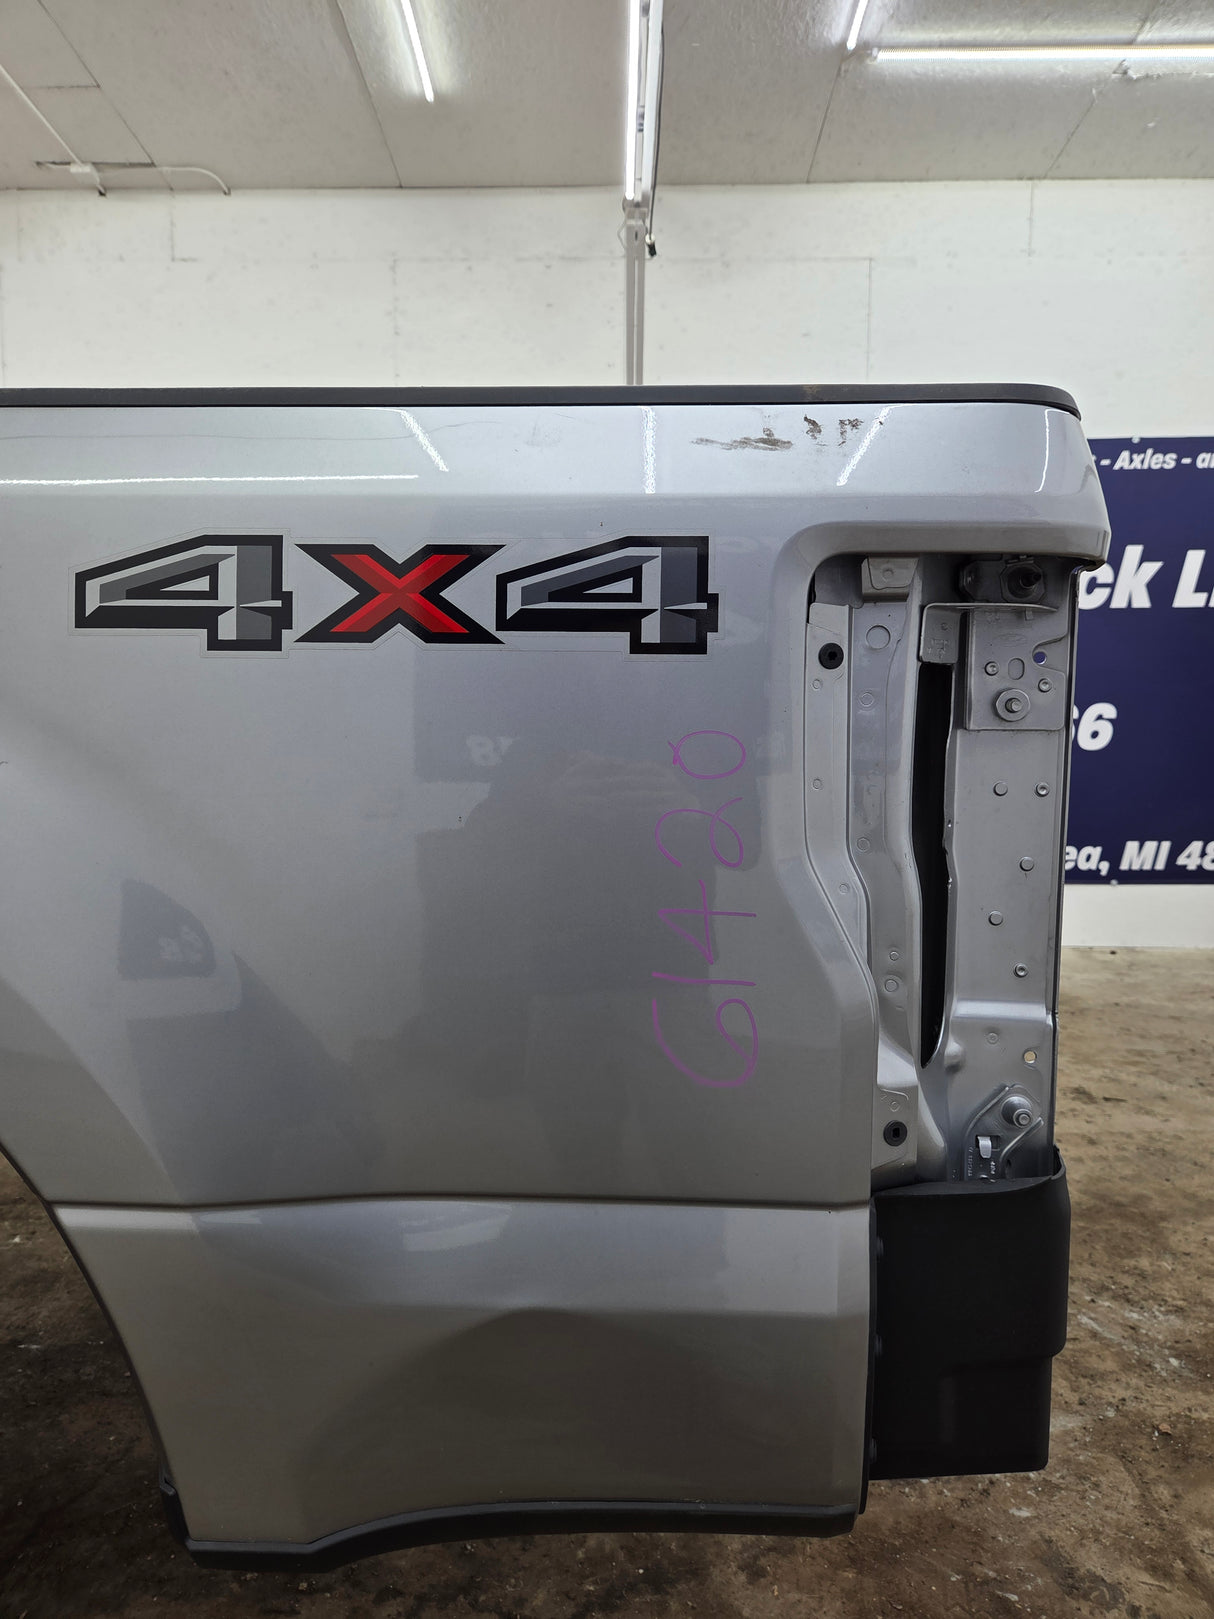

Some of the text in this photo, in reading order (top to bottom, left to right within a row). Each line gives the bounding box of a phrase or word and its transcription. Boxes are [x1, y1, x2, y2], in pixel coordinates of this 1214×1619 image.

[1112, 448, 1178, 470] Axles
[1196, 452, 1214, 469] a
[1172, 549, 1214, 608] L
[1072, 702, 1118, 751] 6
[1119, 840, 1172, 871] MI
